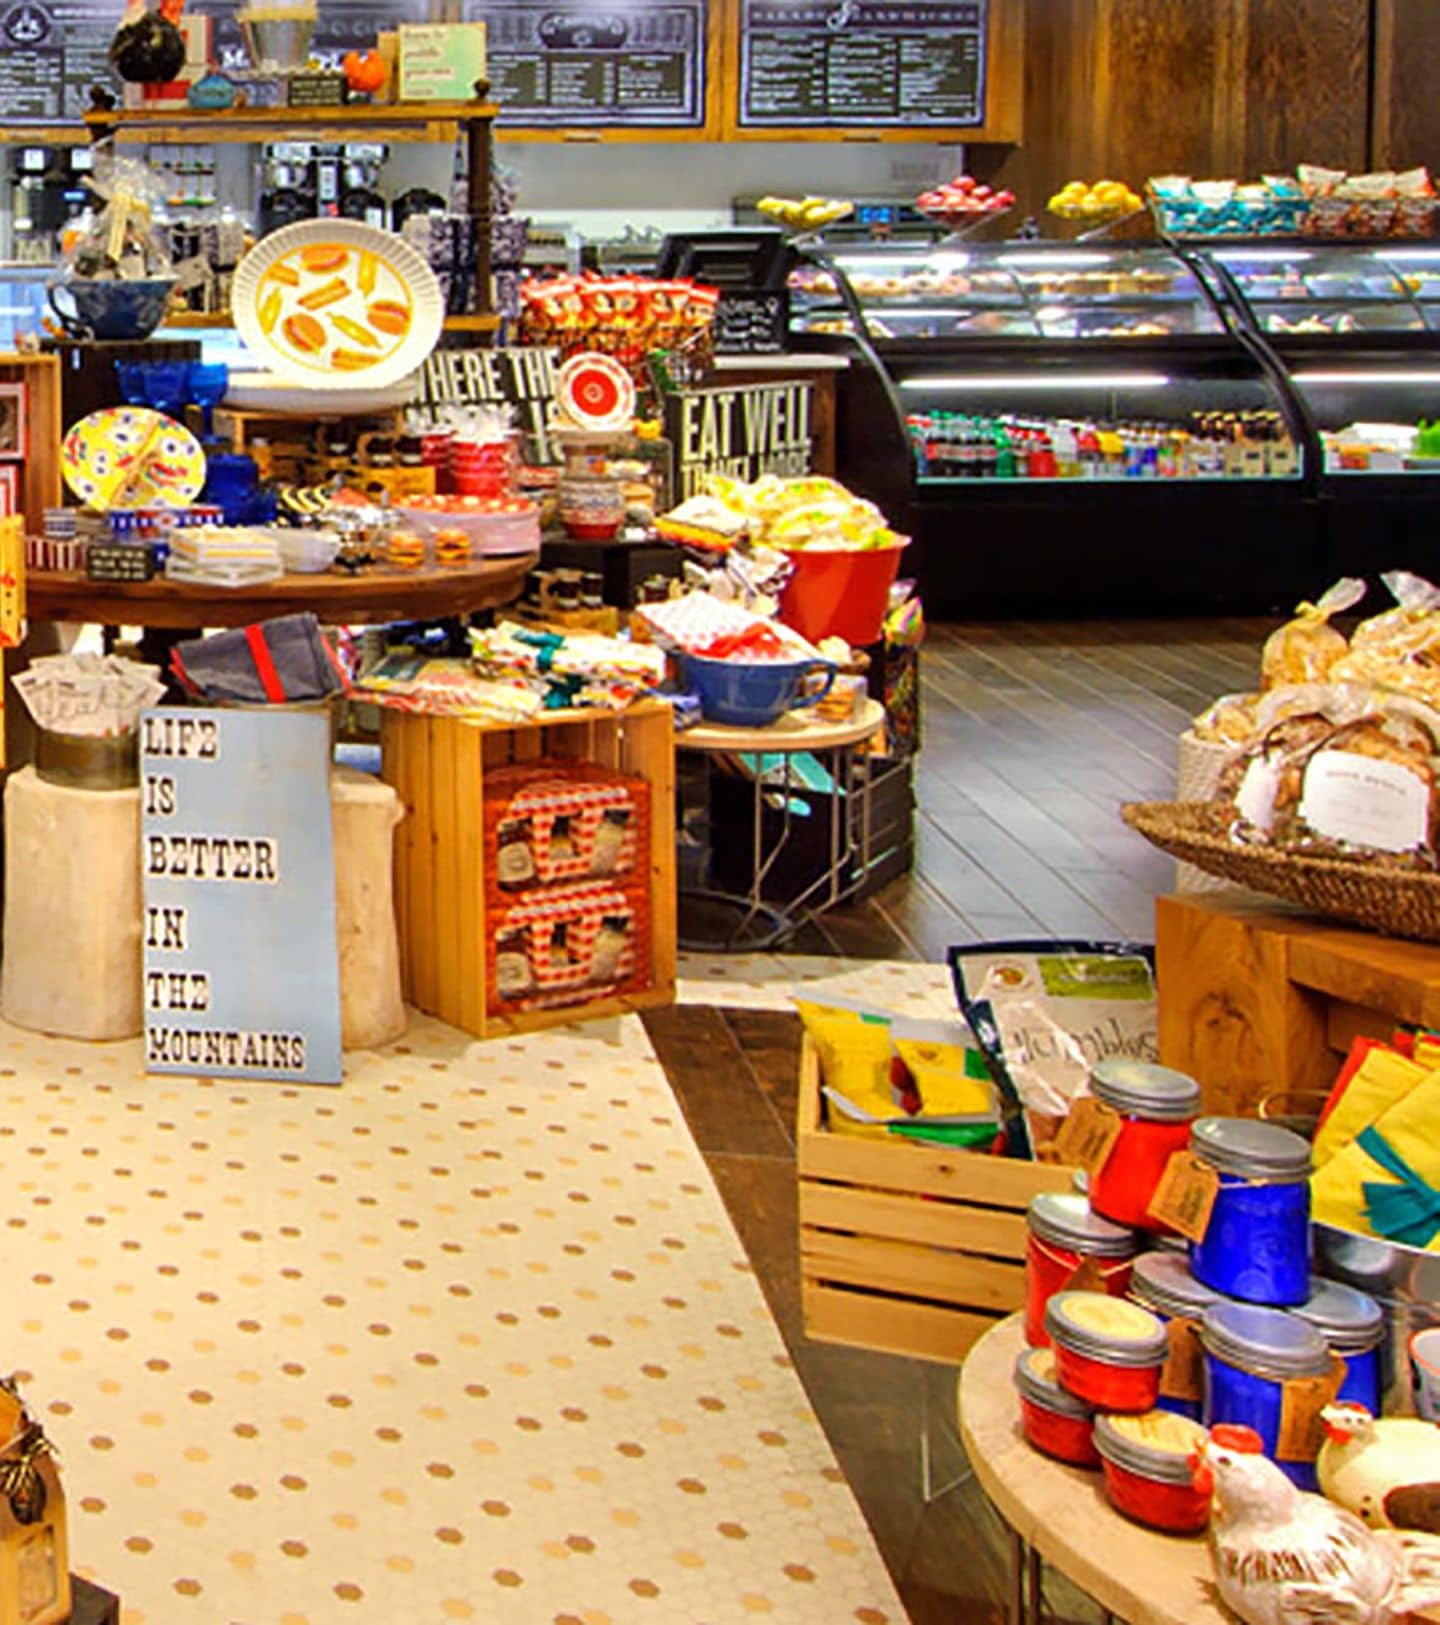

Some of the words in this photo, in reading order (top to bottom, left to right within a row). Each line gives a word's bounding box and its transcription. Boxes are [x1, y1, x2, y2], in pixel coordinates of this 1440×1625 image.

[682, 394, 735, 461] EAT
[744, 385, 812, 454] WELL
[144, 718, 218, 758] LIFE
[147, 777, 175, 814] IS
[148, 836, 276, 879] BETTER
[147, 908, 185, 948] IN
[147, 972, 208, 1010] THE
[148, 1028, 305, 1068] MOUNTAINS
